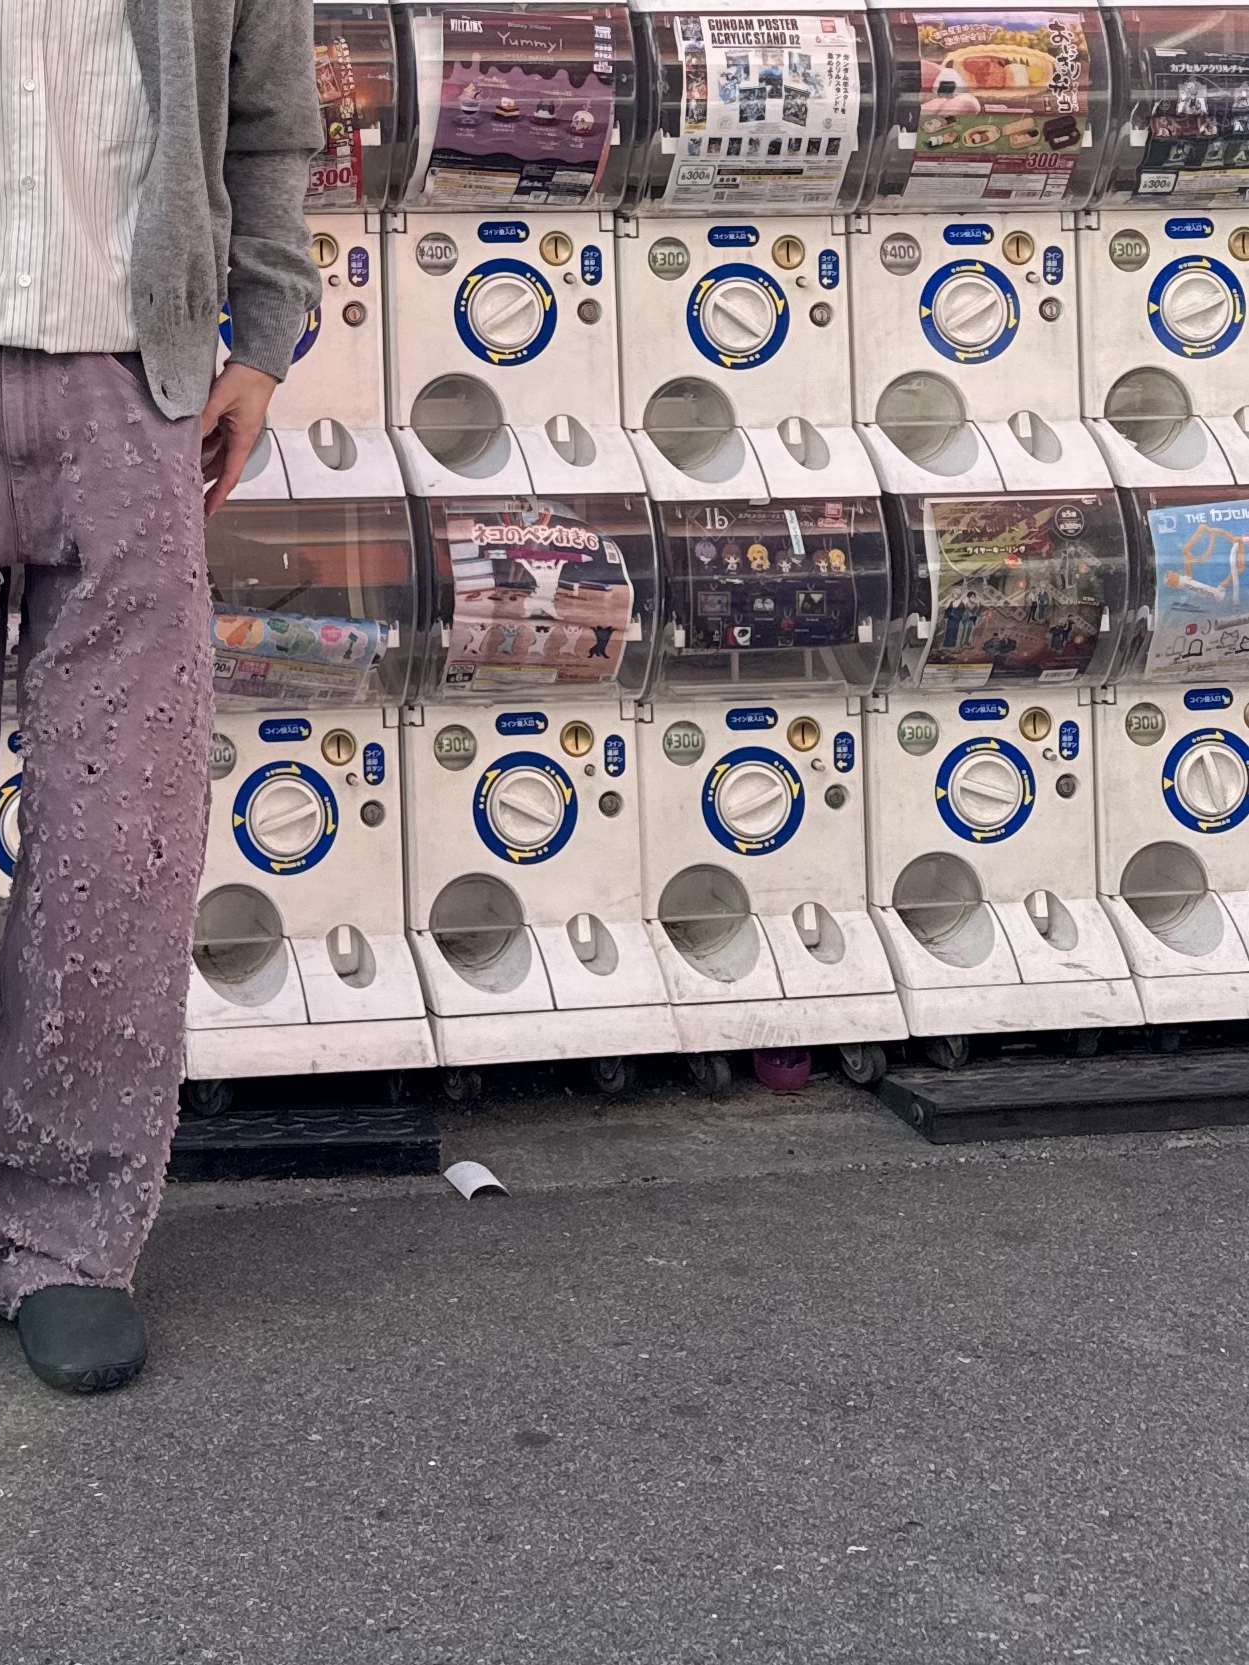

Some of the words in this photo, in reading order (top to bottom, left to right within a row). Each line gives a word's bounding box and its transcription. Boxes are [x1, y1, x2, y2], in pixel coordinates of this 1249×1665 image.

[708, 19, 755, 31] GUNDAM
[758, 18, 799, 30] POSTER
[711, 32, 753, 45] ACRYLIC
[753, 32, 787, 45] STAND
[789, 34, 801, 45] 02
[705, 507, 729, 530] Ib
[1184, 512, 1208, 524] THE
